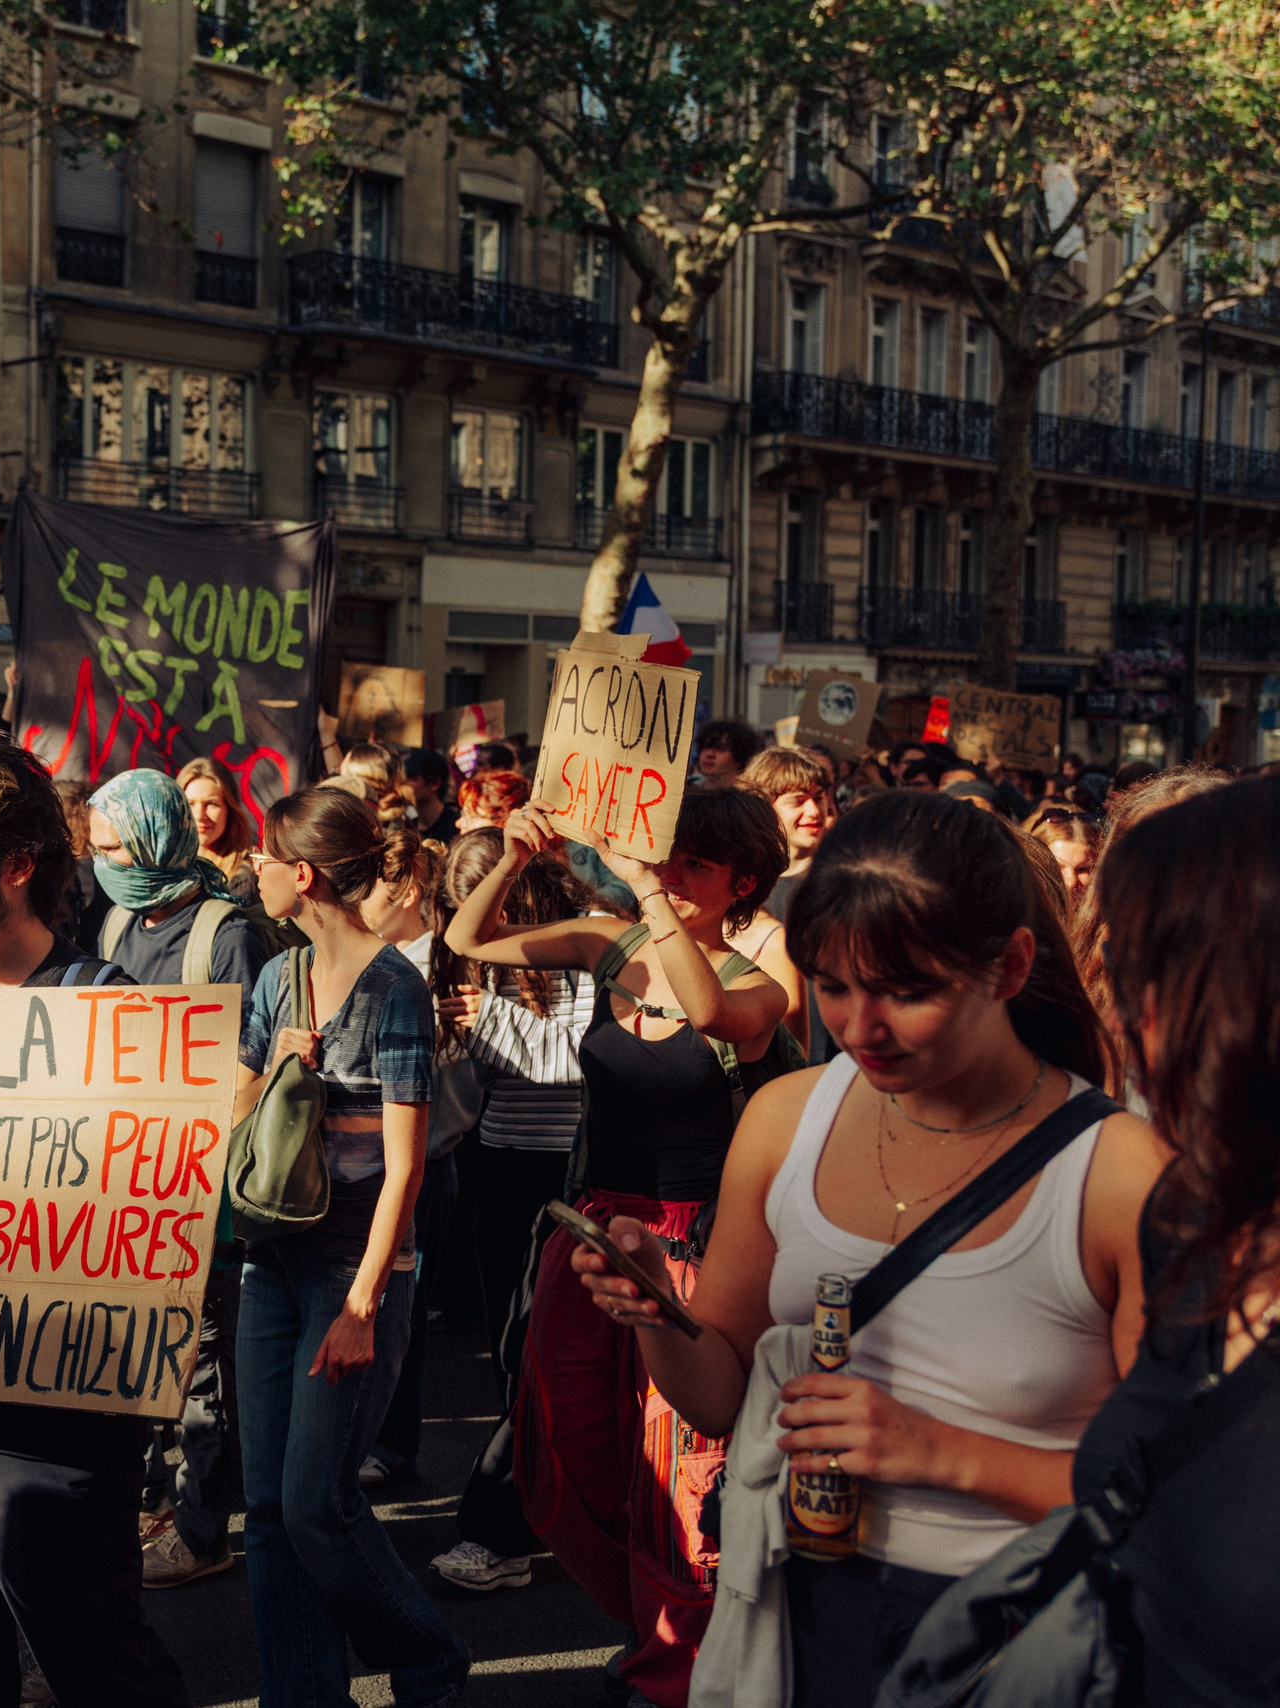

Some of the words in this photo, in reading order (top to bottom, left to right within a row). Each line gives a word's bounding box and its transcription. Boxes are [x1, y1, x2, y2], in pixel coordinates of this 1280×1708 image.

[58, 547, 129, 629] LE
[143, 575, 310, 669] MONDE
[98, 635, 199, 716] EST
[76, 990, 223, 1086] TÊTE
[24, 1116, 90, 1189] PAS
[101, 1110, 220, 1201] PEUR
[25, 1300, 195, 1401] CHŒUR
[794, 1488, 855, 1515] MATE
